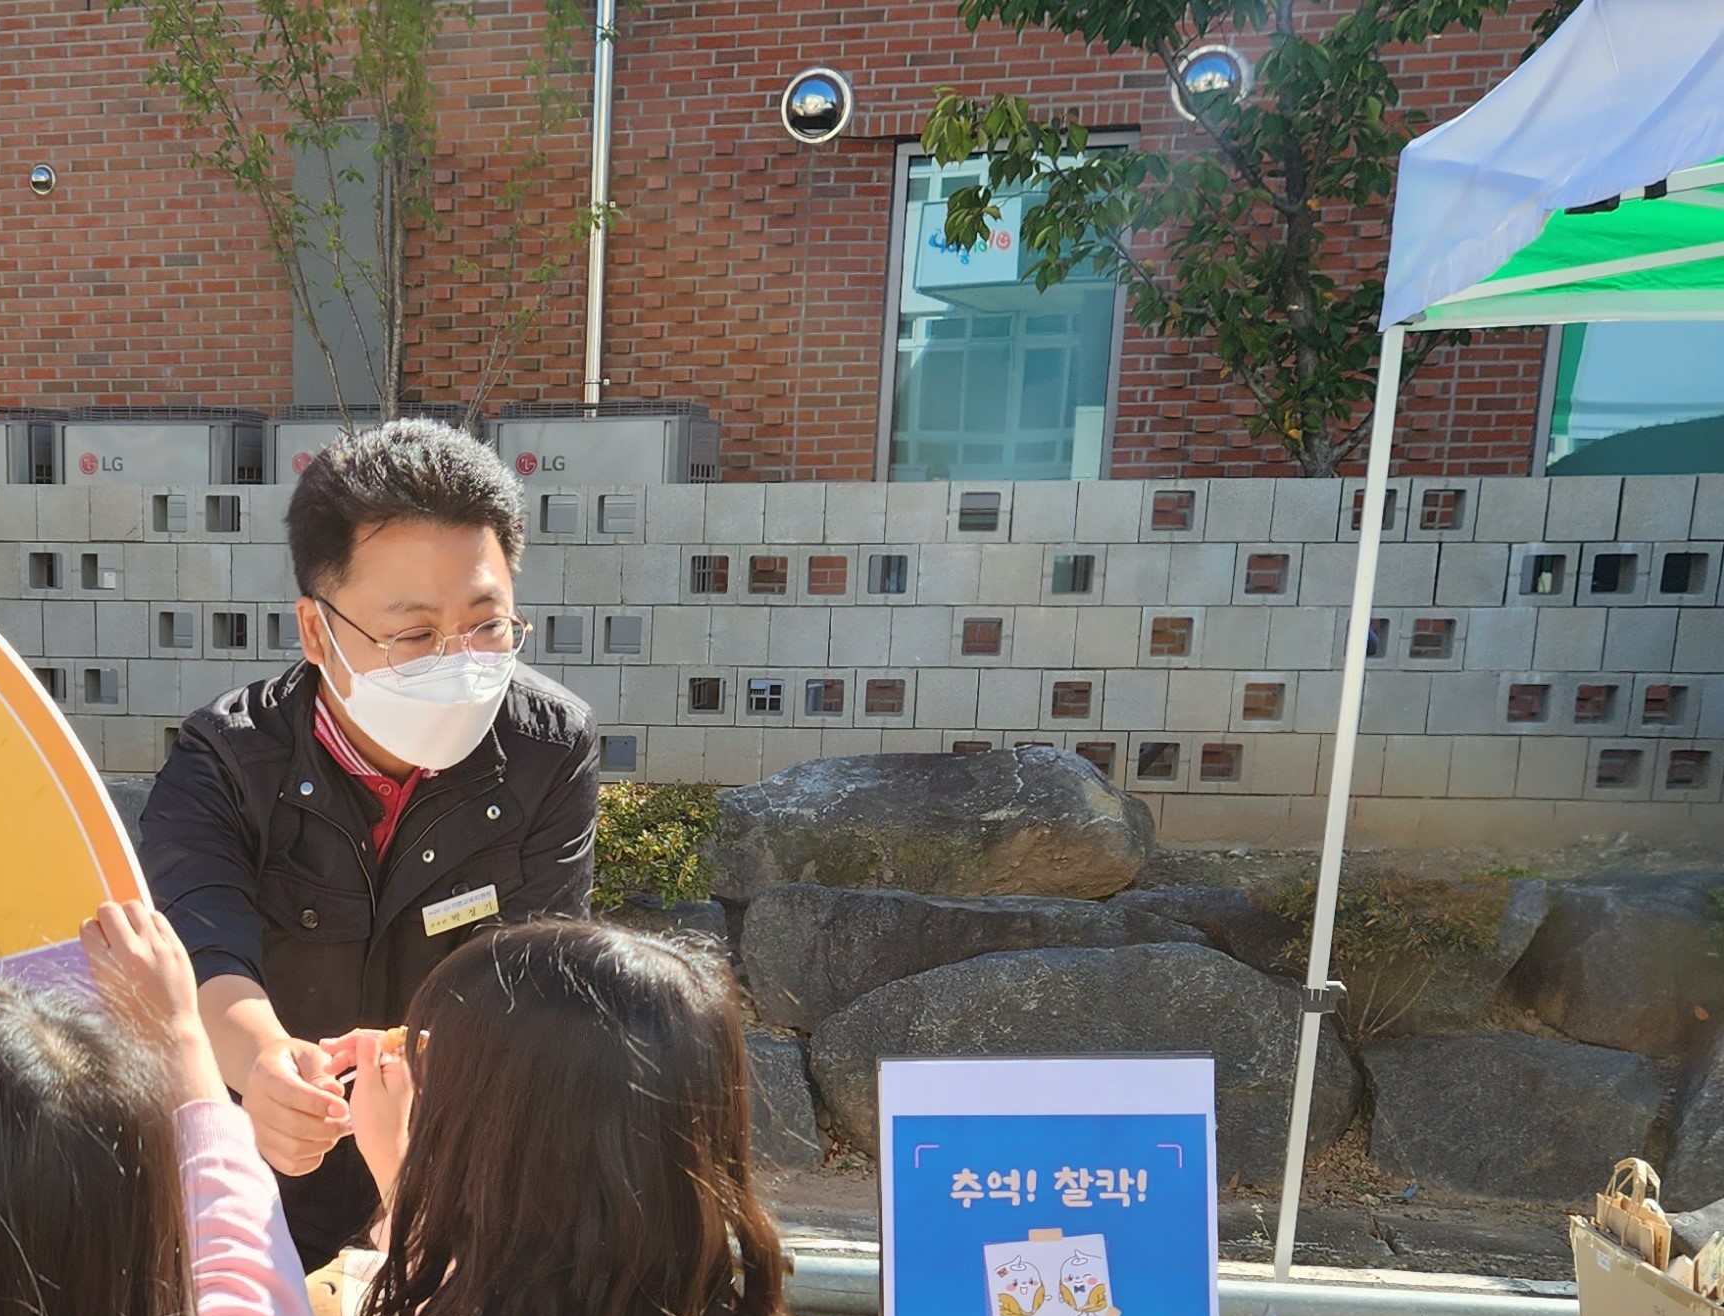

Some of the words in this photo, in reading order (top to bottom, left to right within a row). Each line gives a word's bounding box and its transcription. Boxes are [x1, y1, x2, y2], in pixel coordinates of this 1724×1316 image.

[101, 456, 124, 472] LG
[540, 455, 566, 472] LG
[949, 1166, 1038, 1209] 추억!
[1053, 1165, 1148, 1208] 찰칵!
